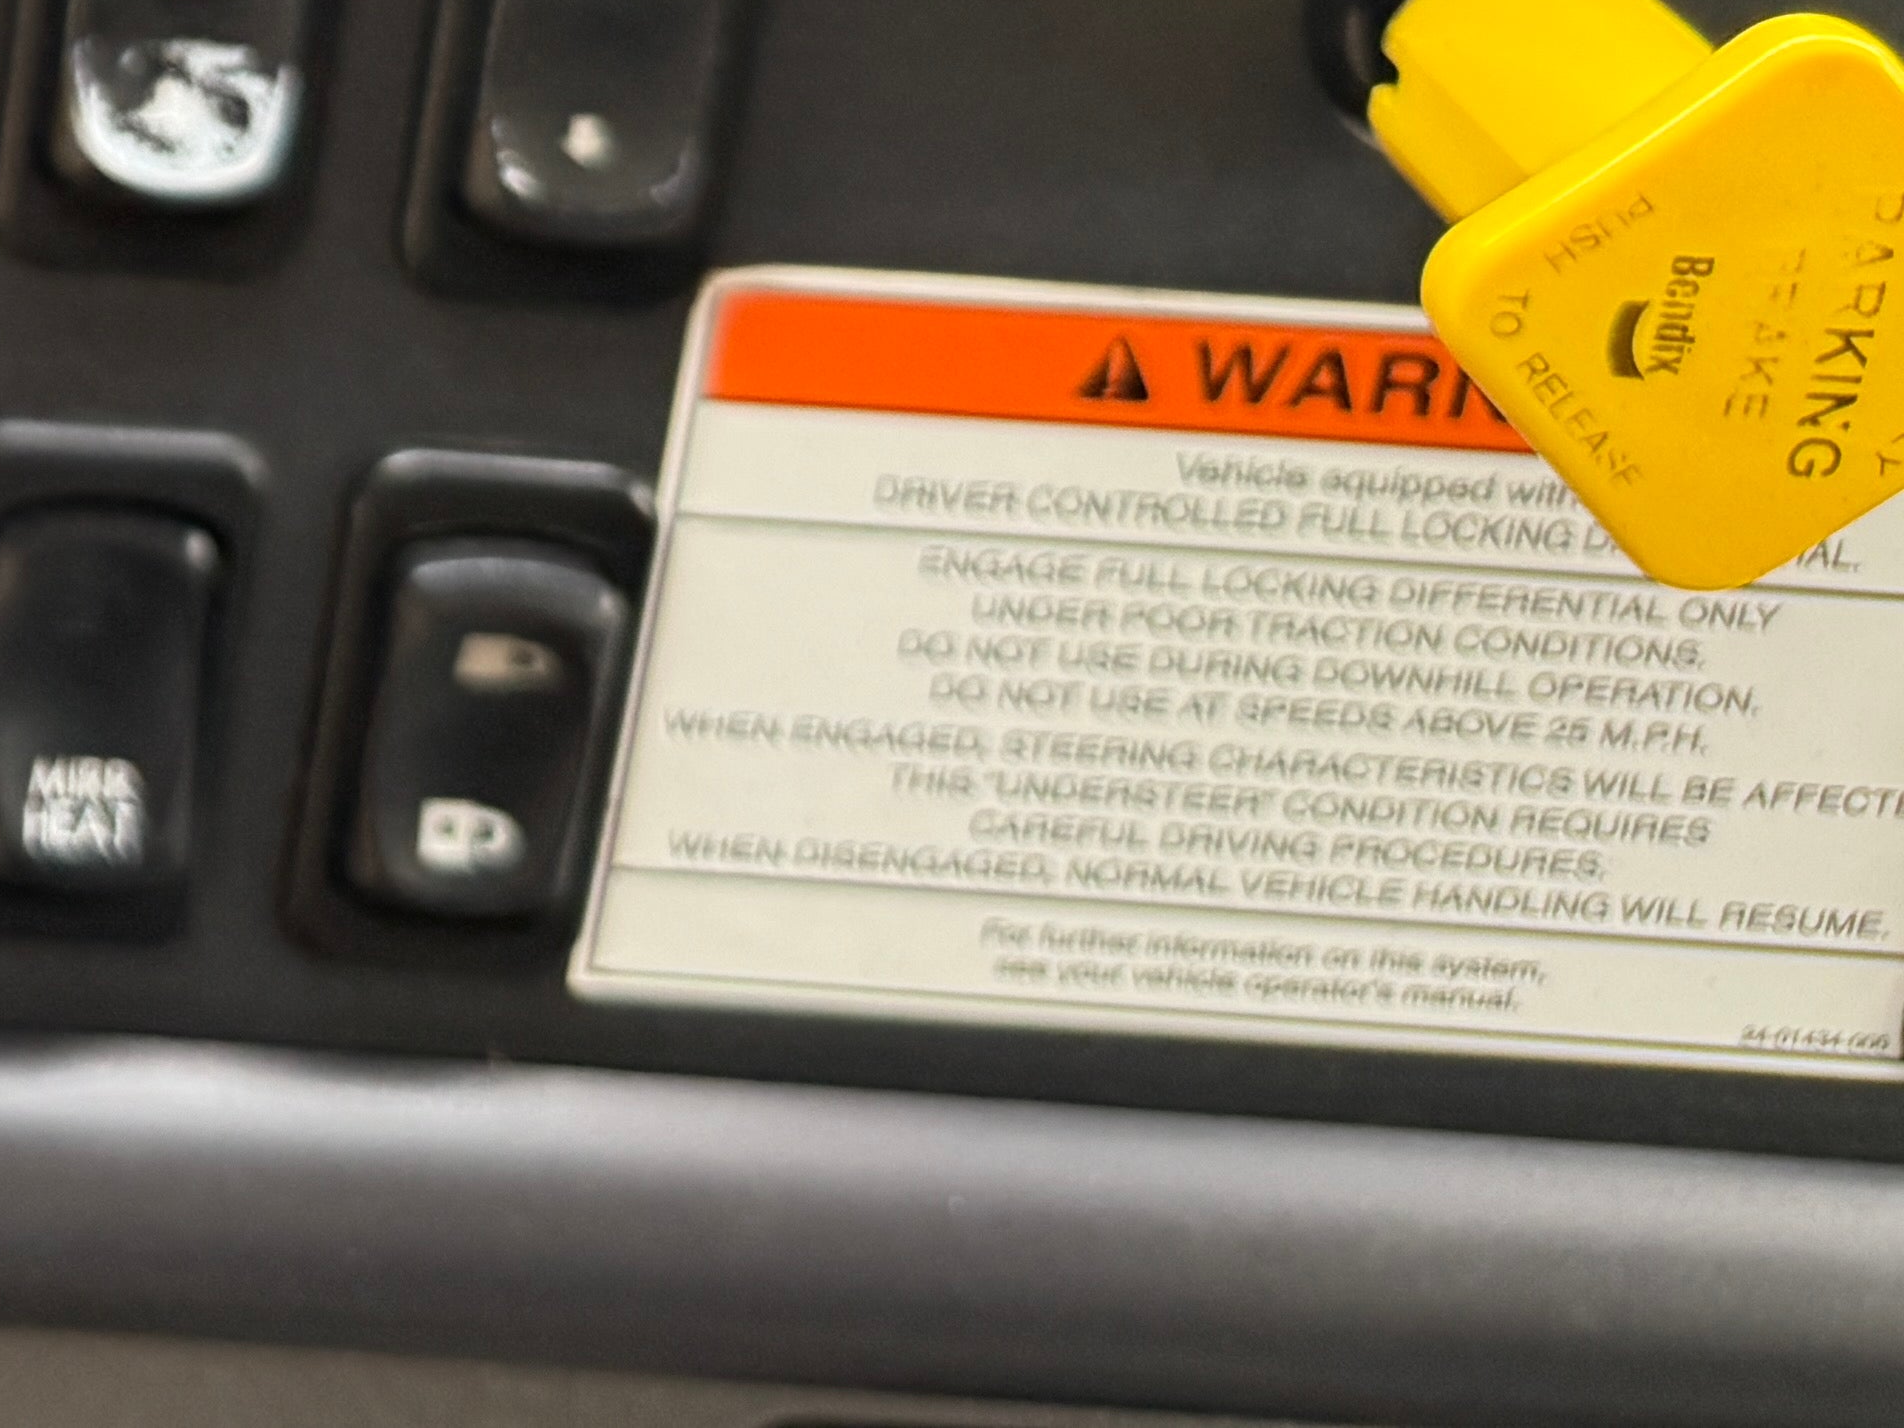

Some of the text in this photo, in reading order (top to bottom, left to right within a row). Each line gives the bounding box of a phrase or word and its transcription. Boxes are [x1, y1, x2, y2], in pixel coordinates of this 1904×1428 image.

[1543, 194, 1654, 274] PUSH
[1490, 289, 1531, 338] TO
[1645, 255, 1715, 376] Bendix
[1195, 336, 1508, 420] WARN
[1517, 352, 1645, 487] RELEASE
[874, 472, 1015, 513] DRIVER
[1026, 483, 1286, 532] CONTROLLED
[1297, 502, 1390, 539] FULL
[1400, 509, 1573, 552] LOCKING
[1176, 451, 1309, 493] Vehicle
[1320, 464, 1496, 511] equipped
[918, 543, 1782, 634] ENGAGE FULL LOCKING DIFFERENTIAL ONLY
[972, 590, 1108, 630] UNDER
[1120, 600, 1239, 639] POOR
[1248, 609, 1440, 653] TRACTION
[897, 627, 957, 661] DO
[965, 632, 1053, 668] NOT
[1058, 638, 1143, 674] USE
[1148, 644, 1303, 685] DURING
[1312, 656, 1517, 700] DOWNHILL
[929, 671, 987, 705] DO
[997, 676, 1083, 712] NOT
[1090, 682, 1170, 718] USE
[1177, 688, 1232, 722] AT
[1234, 692, 1393, 733] SPEEDS
[1405, 704, 1542, 744] ABOVE
[1547, 714, 1592, 747] 25
[665, 704, 782, 742] WHEN
[1000, 727, 1195, 771] STEERING
[1208, 742, 1574, 797] CHARACTERISTICS
[1582, 767, 1677, 804] WILL
[1681, 774, 1735, 808] BE
[891, 762, 976, 797] THIS
[1282, 789, 1498, 834] CONDITION
[1509, 804, 1711, 848] REQUIRES
[967, 809, 1149, 850] CAREFUL
[1159, 822, 1319, 862] DRIVING
[668, 828, 785, 866] WHEN
[1064, 856, 1229, 897] NORMAL
[1241, 868, 1404, 909] VEHICLE
[1411, 880, 1609, 923] HANDLING
[1620, 894, 1707, 930] WILL
[981, 919, 1032, 947] For
[1145, 930, 1312, 967] information
[1323, 942, 1359, 970] on
[1370, 946, 1424, 974] this
[1132, 962, 1235, 992] vehicle
